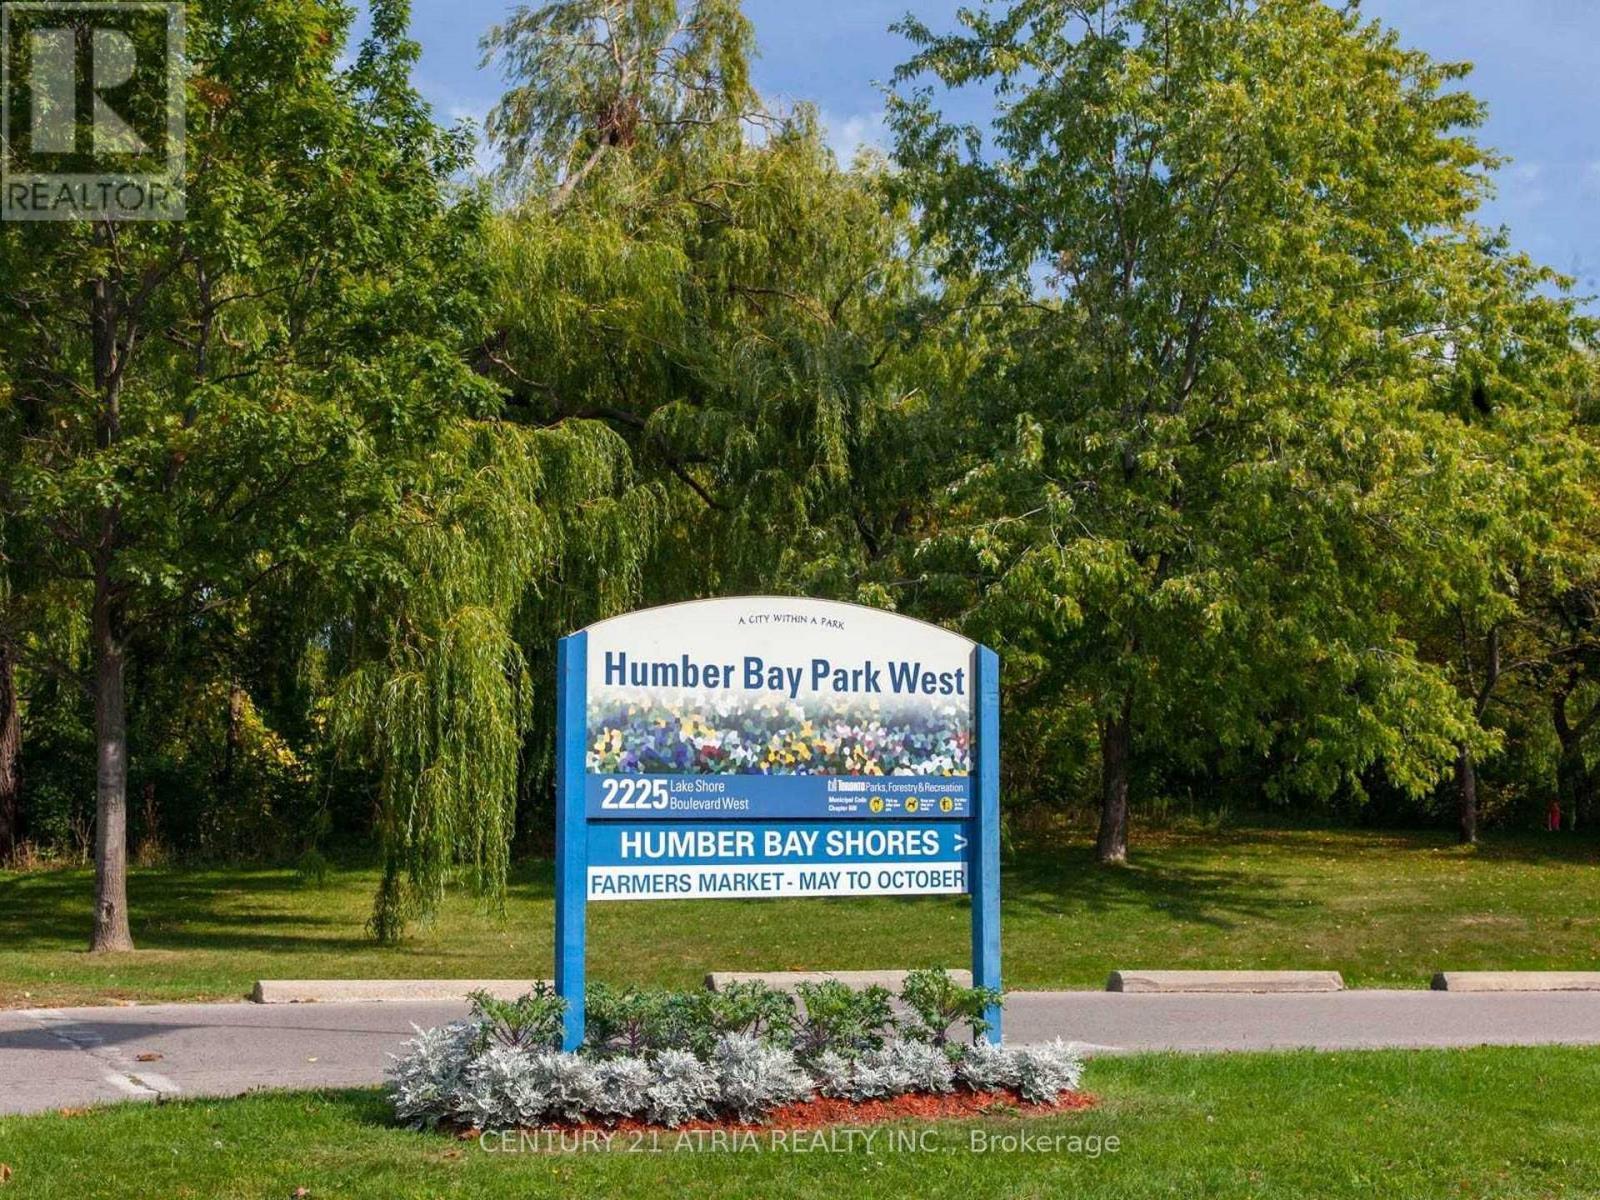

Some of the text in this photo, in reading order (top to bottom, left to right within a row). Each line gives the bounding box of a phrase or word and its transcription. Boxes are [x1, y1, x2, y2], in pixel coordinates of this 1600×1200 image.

[749, 615, 770, 624] CITY
[773, 614, 807, 624] WITHIN
[811, 617, 818, 625] A
[821, 617, 845, 630] PARK
[605, 651, 965, 699] Humber Bay Park West
[602, 779, 668, 809] 2225
[671, 780, 724, 792] Lake Shore
[888, 782, 917, 794] Forestry
[918, 782, 925, 792] &
[925, 782, 964, 792] Recreation
[671, 797, 749, 810] Boulevard West
[620, 830, 940, 858] HUMBER BAY SHORES
[592, 874, 692, 894] FARMERS
[699, 872, 785, 892] MARKET
[800, 871, 841, 890] MAY
[846, 871, 871, 890] TO
[878, 870, 965, 889] OCTOBER
